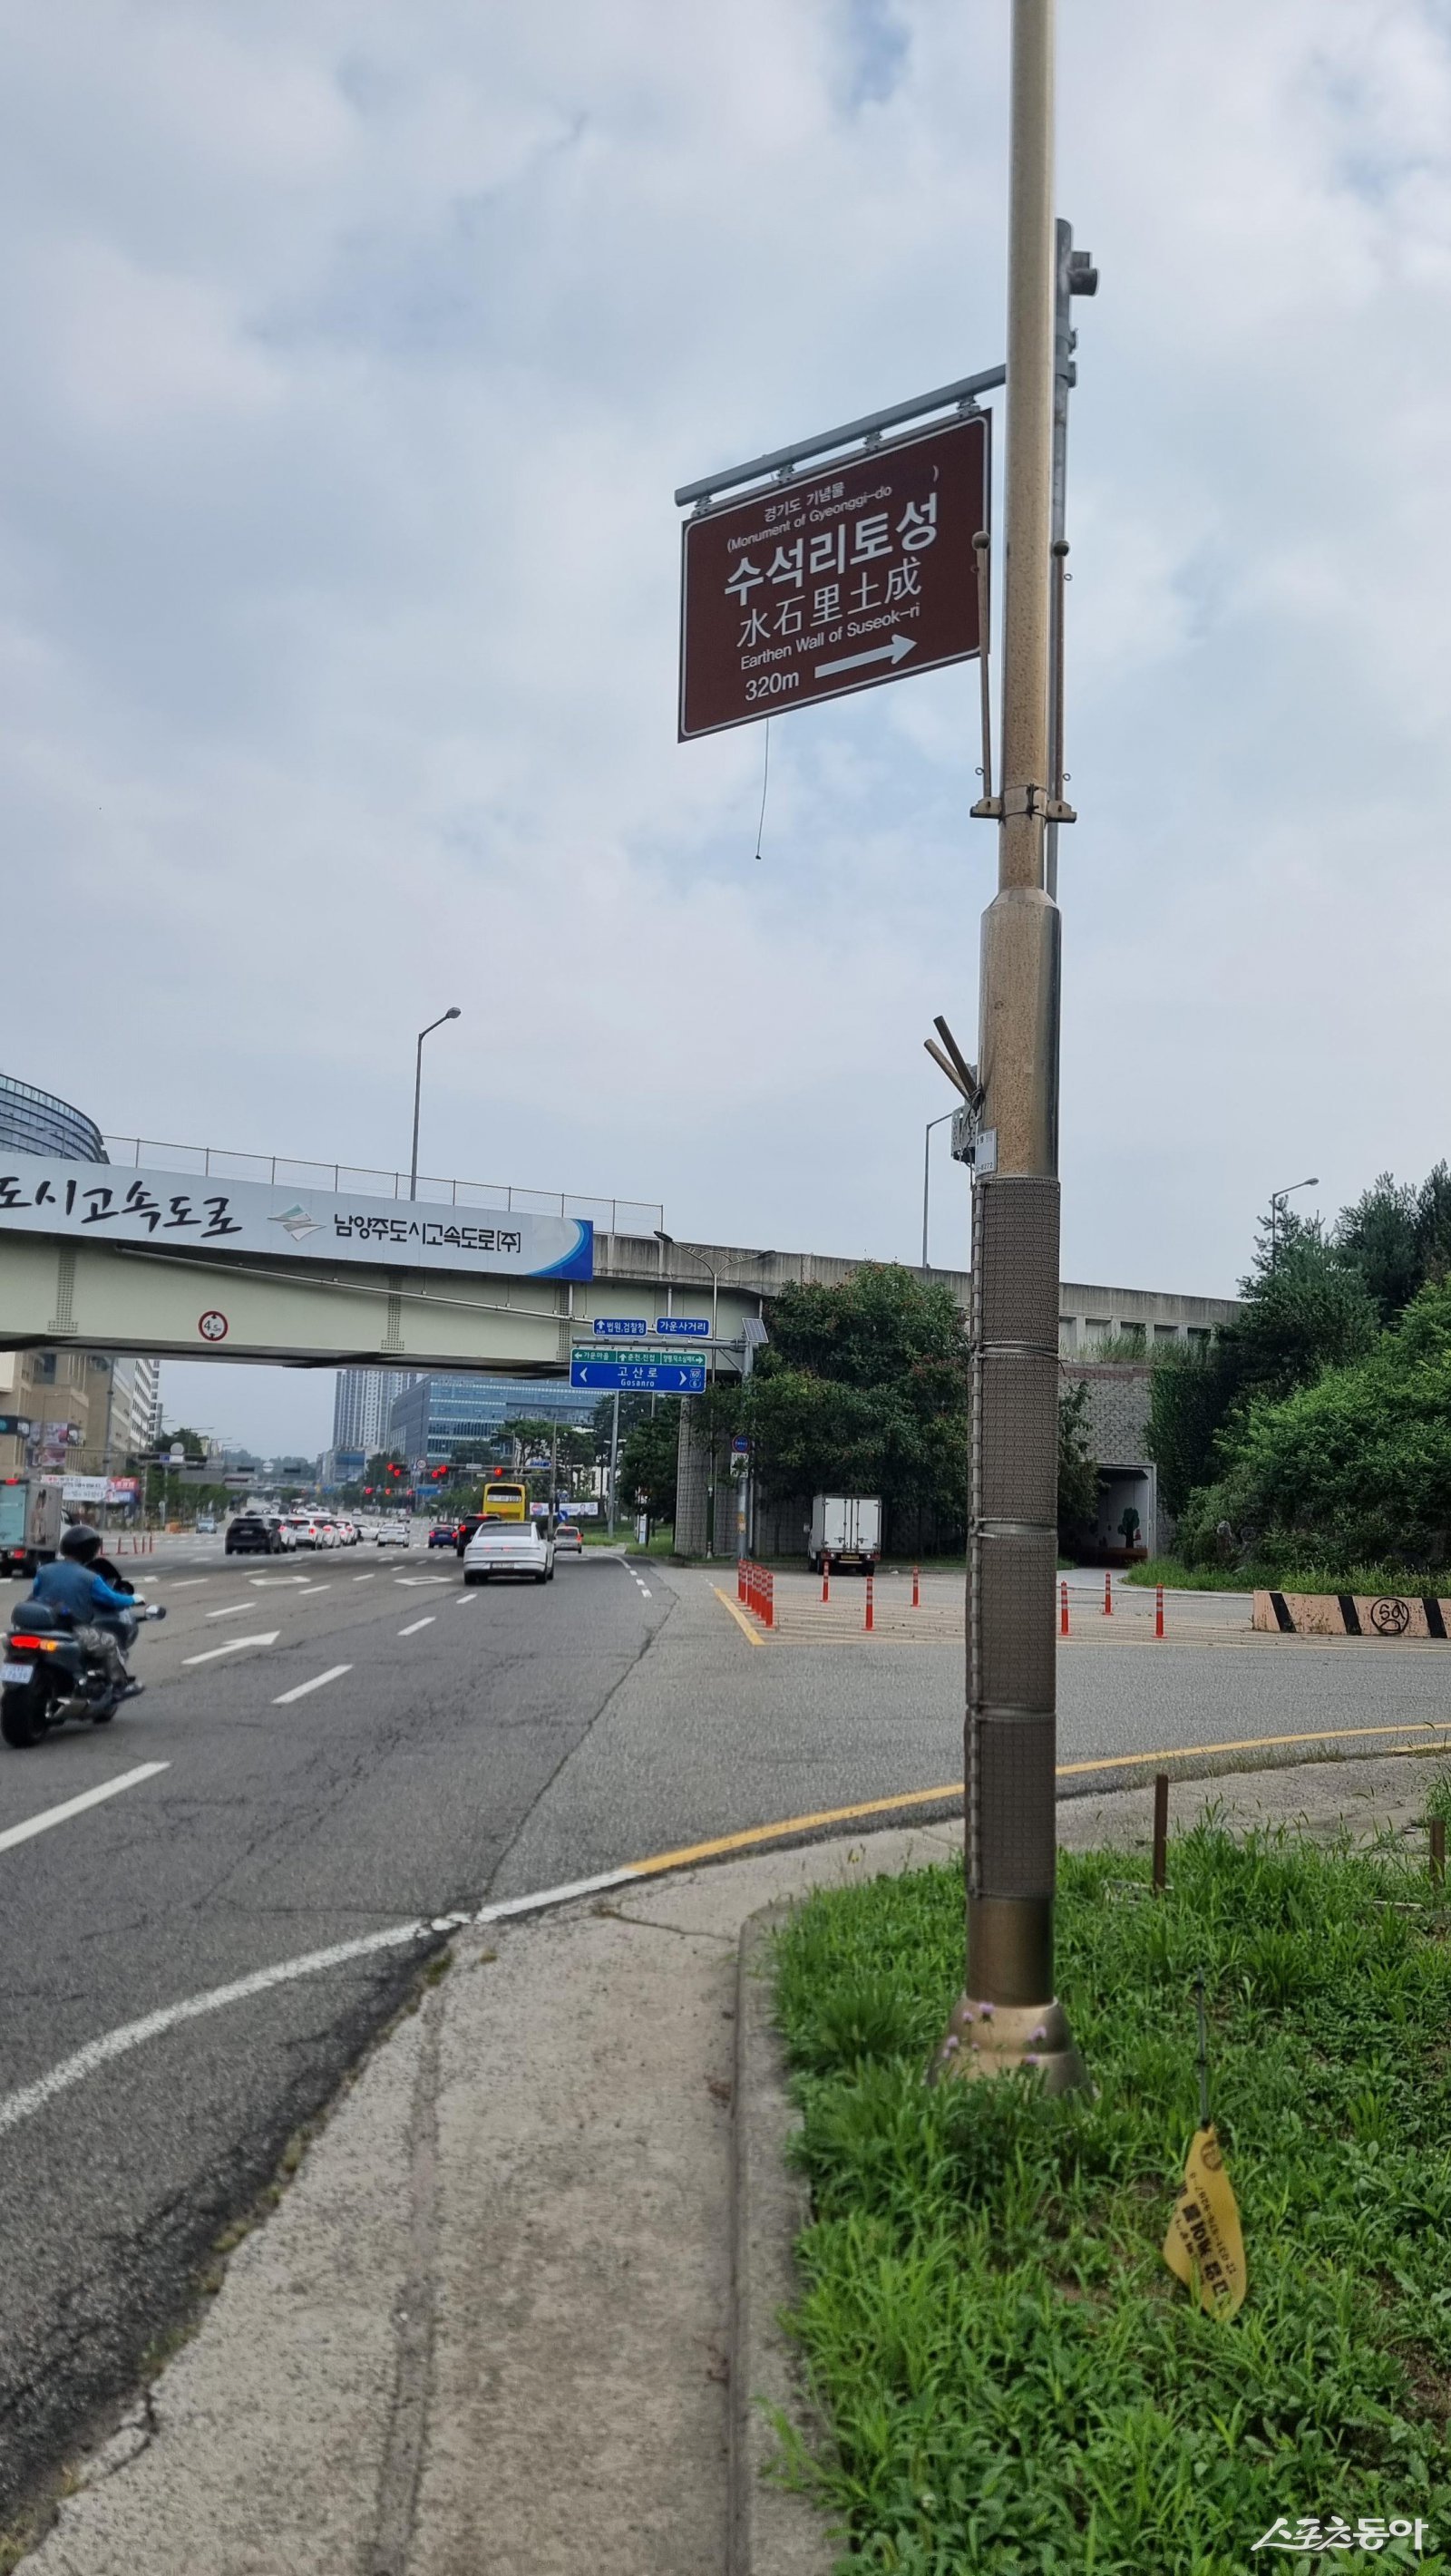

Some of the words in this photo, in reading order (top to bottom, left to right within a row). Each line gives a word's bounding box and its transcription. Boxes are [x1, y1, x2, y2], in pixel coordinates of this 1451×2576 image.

[727, 520, 791, 553] (Monument
[794, 513, 806, 529] of
[809, 485, 892, 522] Gyeonggi-do
[764, 498, 802, 523] 경기도
[806, 481, 845, 507] 기념물
[725, 492, 938, 607] 수석리토성
[736, 556, 922, 648] 水石里土成
[740, 646, 792, 670] Earthen
[795, 636, 824, 653] Wall
[829, 627, 842, 643] of
[847, 602, 920, 637] Suseok-ri
[745, 671, 800, 701] 320m
[0, 1176, 243, 1239] 도시고속도로
[659, 1320, 706, 1333] 가운사거리
[583, 1351, 609, 1361] 가운마을
[618, 1366, 658, 1379] 고산로
[620, 1378, 655, 1387] Gosanro
